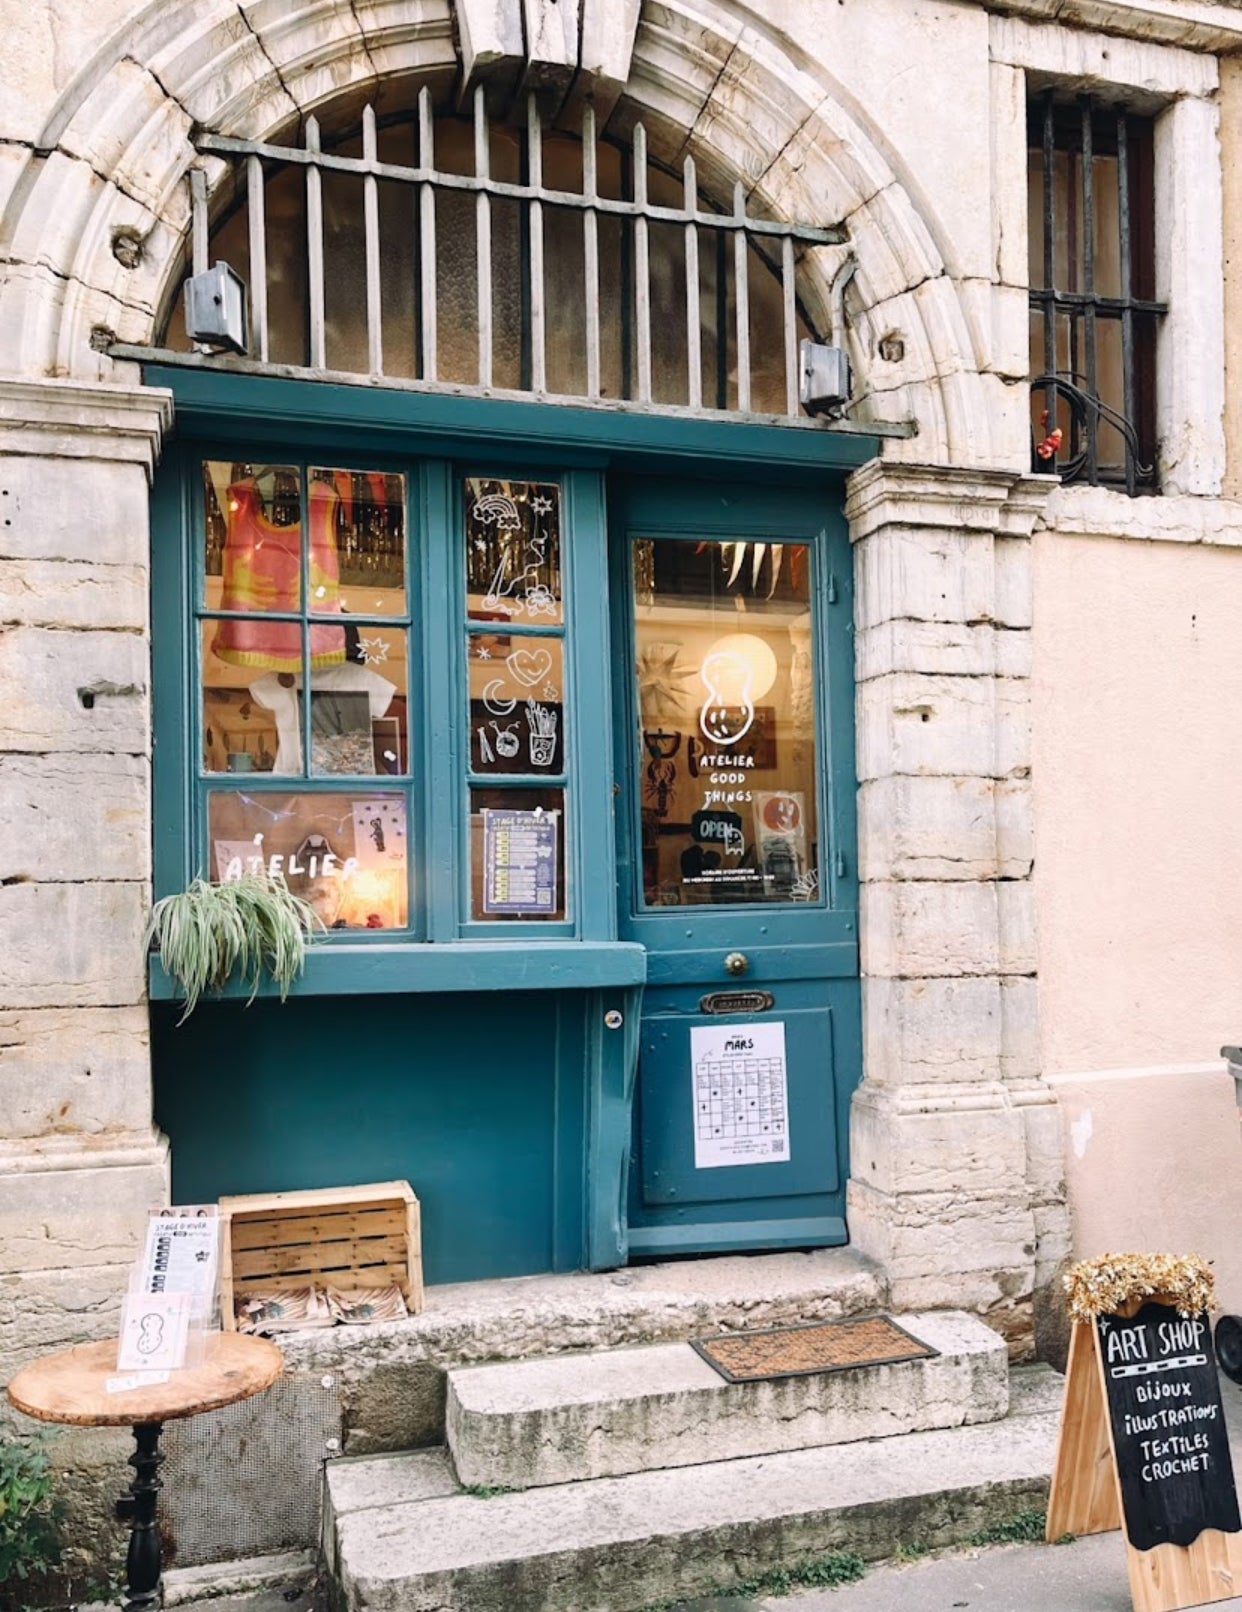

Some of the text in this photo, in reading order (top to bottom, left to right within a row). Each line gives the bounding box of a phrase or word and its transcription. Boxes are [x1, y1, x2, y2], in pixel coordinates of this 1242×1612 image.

[700, 755, 755, 767] ATELIER
[710, 772, 745, 784] GOOD
[704, 791, 752, 802] THINGS
[700, 820, 733, 837] OPEN
[225, 854, 359, 880] ATELIER
[724, 1039, 754, 1051] MARS
[1108, 1320, 1205, 1363] ART SHOP
[1141, 1452, 1210, 1482] CROCHET
